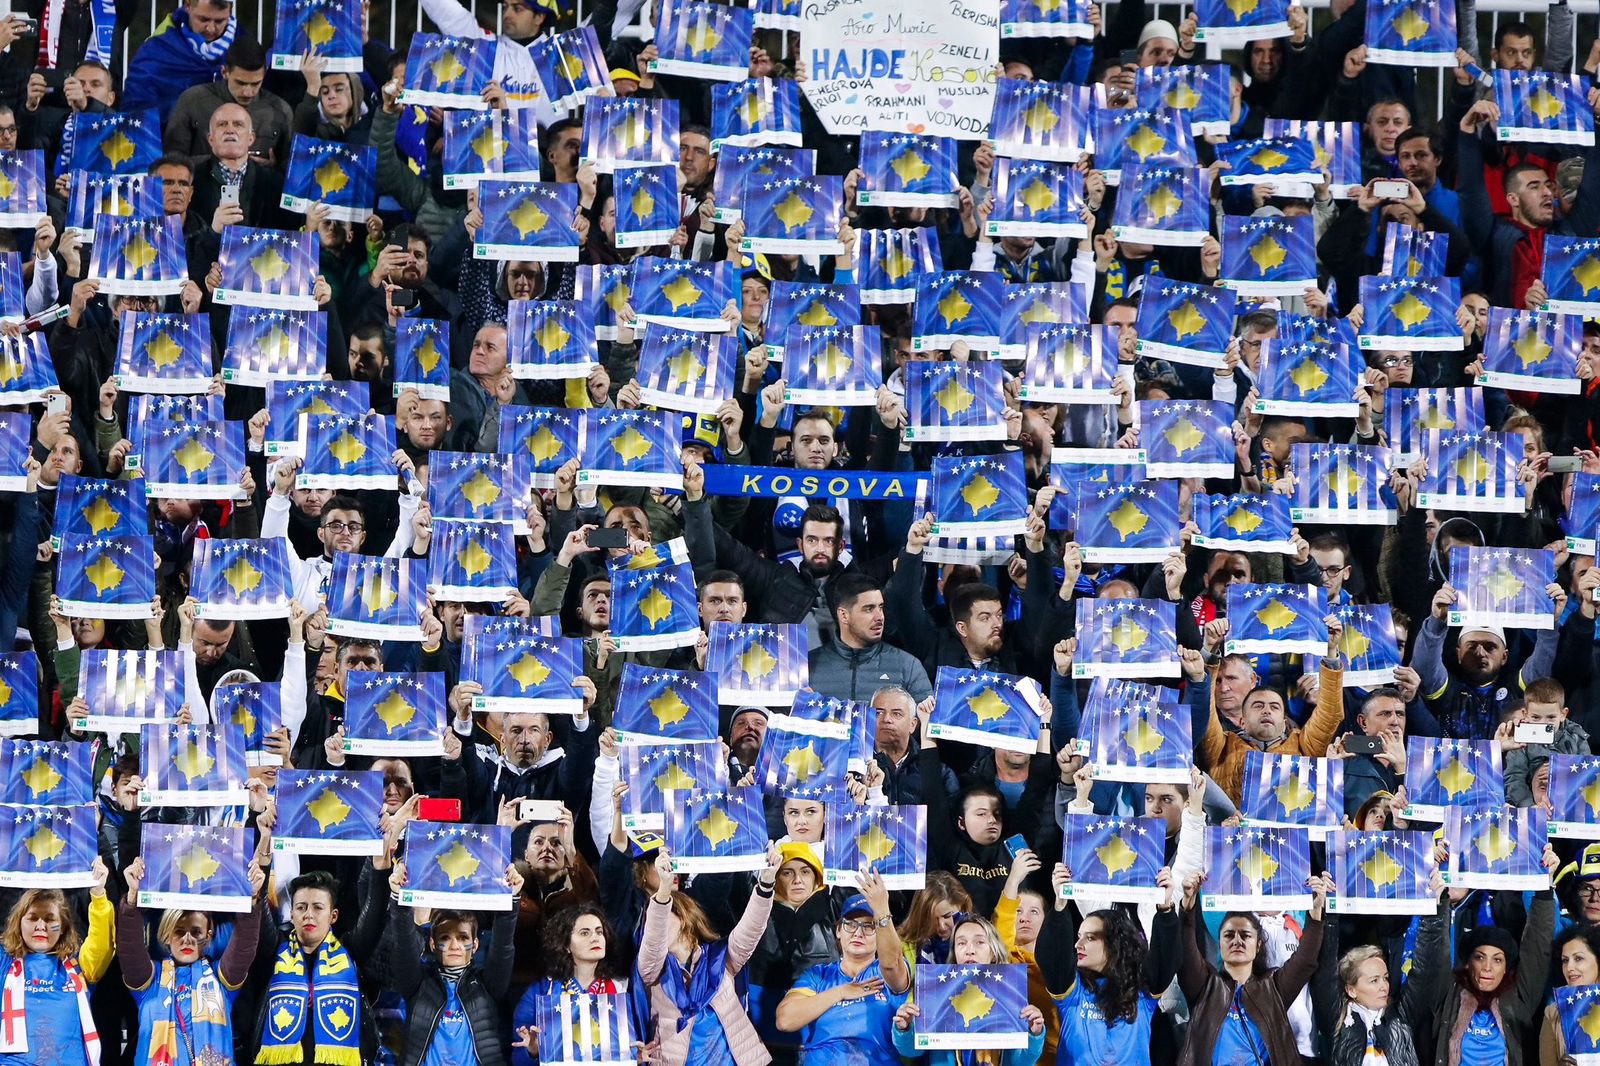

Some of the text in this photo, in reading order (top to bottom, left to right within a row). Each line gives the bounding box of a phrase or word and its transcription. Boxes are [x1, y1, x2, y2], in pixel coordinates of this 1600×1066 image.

[949, 0, 998, 29] BERISHA
[812, 48, 905, 81] HAJDE
[938, 43, 990, 61] ZENELI
[807, 78, 874, 97] ZHEGROVA
[878, 111, 909, 121] ALITI
[926, 110, 990, 135] VOJVODA
[741, 473, 905, 498] KOSOVA
